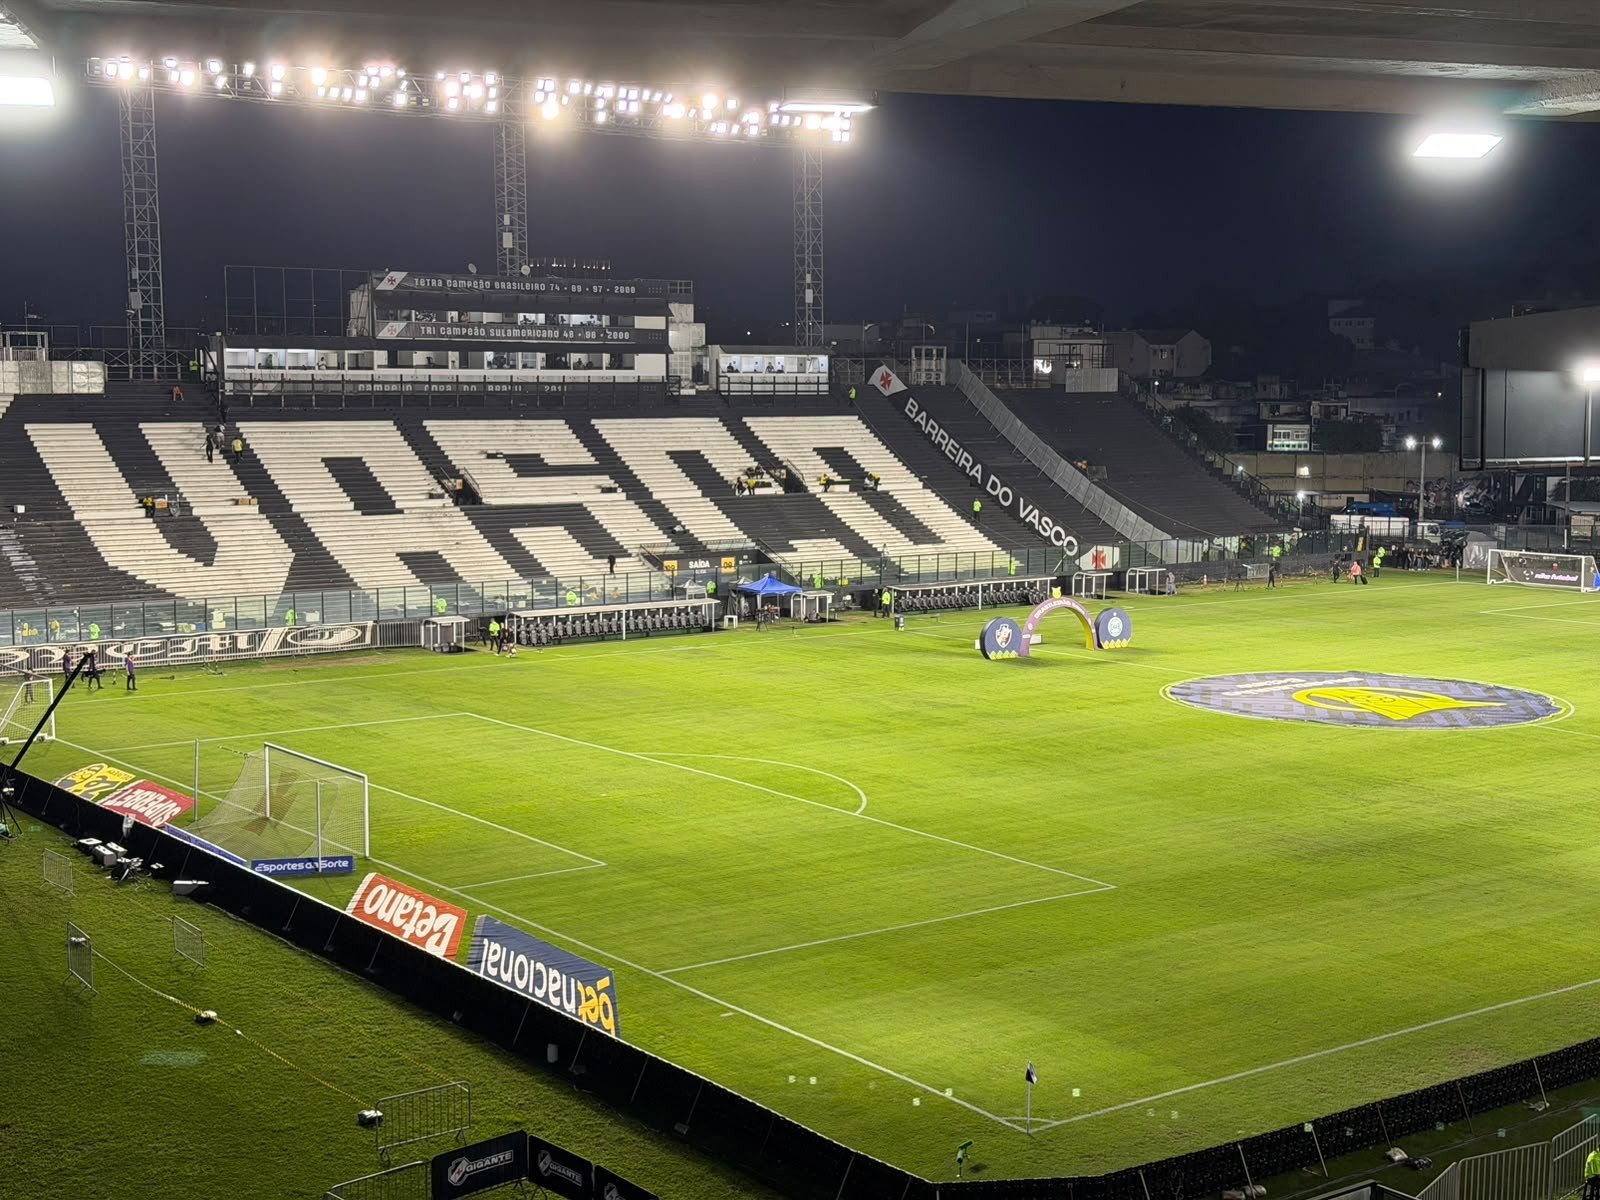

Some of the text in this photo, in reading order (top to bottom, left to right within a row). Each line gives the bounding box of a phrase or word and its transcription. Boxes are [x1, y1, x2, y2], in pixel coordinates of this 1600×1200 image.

[550, 283, 560, 291] 74
[614, 285, 636, 293] 2000
[420, 326, 436, 335] TRI
[606, 331, 630, 340] 2000
[904, 397, 1078, 557] BARREIRA DO VASCO
[24, 415, 1022, 622] VASCO
[688, 558, 710, 569] SAÍDA
[102, 788, 182, 827] SUPERBET
[254, 861, 304, 873] Esportes
[319, 860, 349, 869] Sorte
[363, 884, 459, 957] Betano
[480, 938, 616, 1037] betnacional
[465, 1151, 512, 1172] GIGANTE
[549, 1162, 582, 1182] GIGANTE
